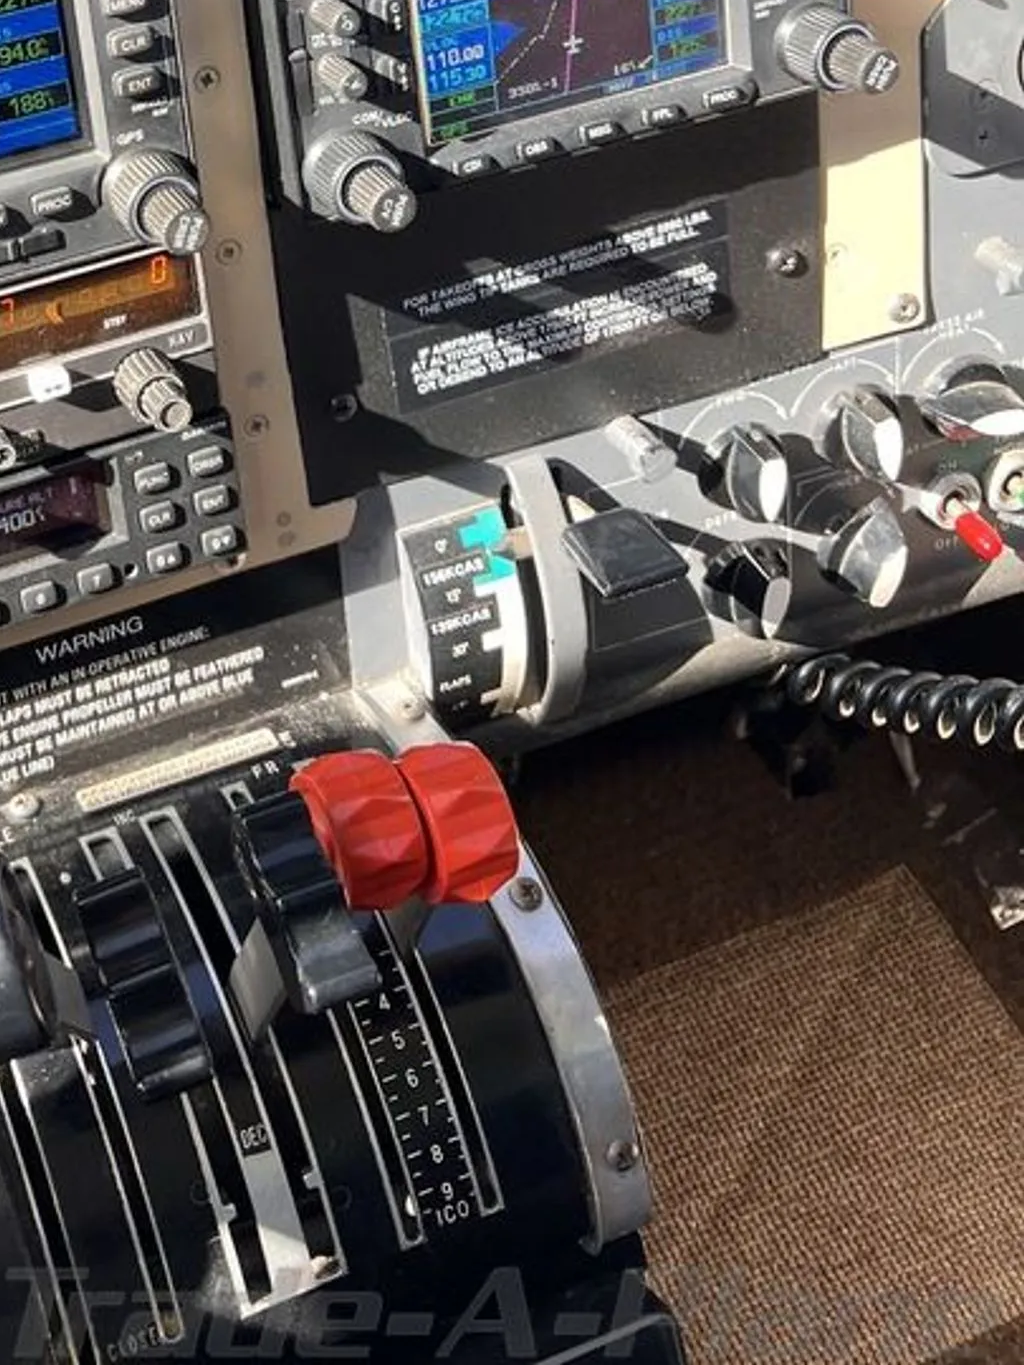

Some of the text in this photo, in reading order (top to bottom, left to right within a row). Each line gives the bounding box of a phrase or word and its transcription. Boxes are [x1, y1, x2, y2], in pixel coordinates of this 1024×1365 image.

[36, 616, 143, 663] WARNING
[12, 680, 46, 702] WITH
[50, 674, 70, 689] AN
[85, 644, 158, 677] OPERATIVE
[13, 714, 59, 742] ENGINE
[63, 688, 133, 724] PROPELLER
[135, 676, 171, 701] MUST
[174, 671, 191, 686] BE
[193, 646, 264, 677] FEATHERED
[34, 690, 72, 714] MUST
[76, 683, 93, 700] BE
[96, 657, 170, 690] RETRACTED
[35, 736, 53, 753] BE
[56, 708, 136, 746] MAINTAINED
[138, 699, 157, 715] AT
[159, 694, 176, 709] OR
[179, 679, 219, 703] ABOVE
[222, 668, 254, 688] BLUE
[378, 993, 390, 1011] 4
[392, 1032, 406, 1050] 5
[407, 1068, 419, 1088] 6
[418, 1106, 430, 1126] 7
[430, 1145, 444, 1163] 8
[442, 1183, 454, 1202] 9
[435, 1201, 469, 1226] ICO
